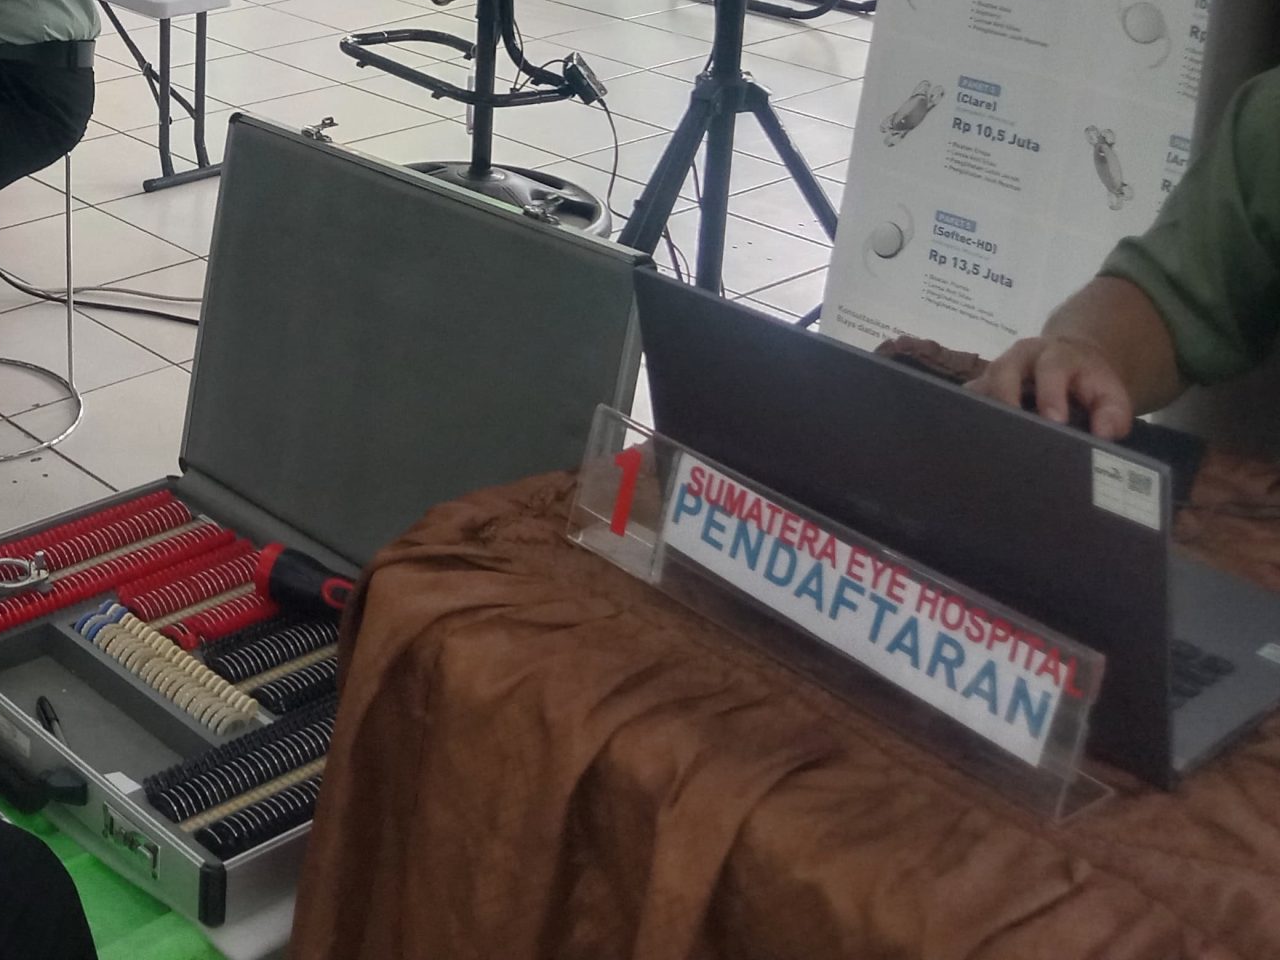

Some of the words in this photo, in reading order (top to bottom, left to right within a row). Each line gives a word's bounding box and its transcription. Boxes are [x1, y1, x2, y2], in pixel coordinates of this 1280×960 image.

[957, 91, 998, 112] (Clare)
[952, 117, 972, 134] Rp
[976, 123, 1006, 142] 10,5
[1008, 134, 1040, 152] Juta
[933, 224, 998, 255] (Softec-HD)
[929, 248, 947, 266] Rp
[952, 256, 981, 276] 13,5
[982, 268, 1013, 288] Juta
[610, 448, 642, 537] 1
[687, 465, 837, 570] SUMATERA
[846, 545, 911, 604] EYE
[916, 581, 1084, 700] HOSPITAL
[672, 482, 1052, 740] PENDAFTARAN
